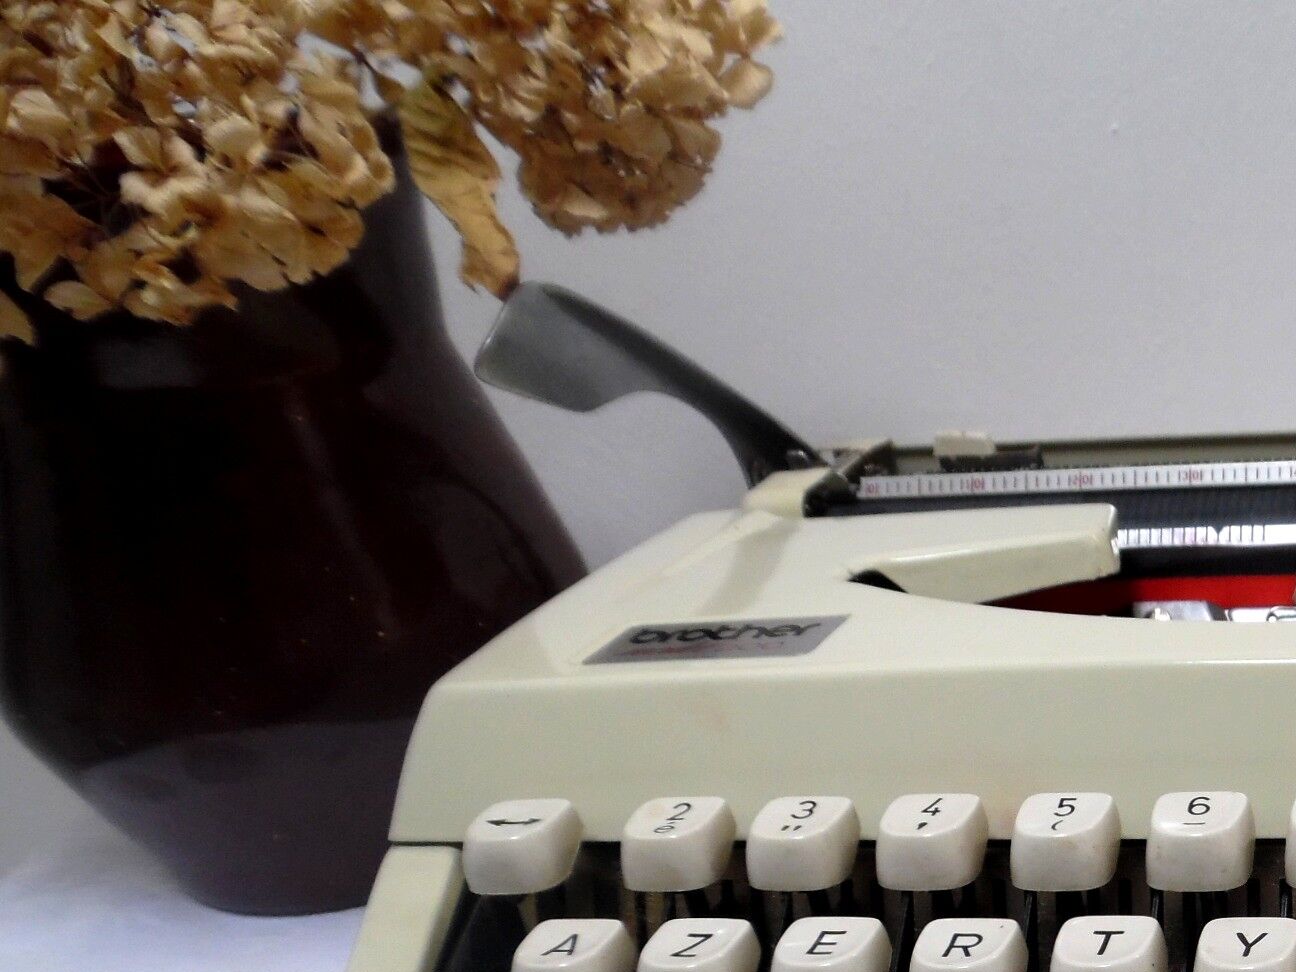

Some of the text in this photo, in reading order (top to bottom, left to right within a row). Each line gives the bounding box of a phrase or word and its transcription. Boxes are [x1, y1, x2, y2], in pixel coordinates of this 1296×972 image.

[666, 802, 692, 821] 2
[790, 800, 818, 820] 3
[921, 797, 943, 817] 4
[1053, 797, 1077, 817] 5
[1187, 796, 1211, 816] 6
[541, 933, 579, 956] A
[669, 933, 714, 958] Z
[805, 930, 848, 956] E
[941, 932, 984, 958] R
[1092, 930, 1125, 956] T
[1236, 932, 1269, 958] Y
